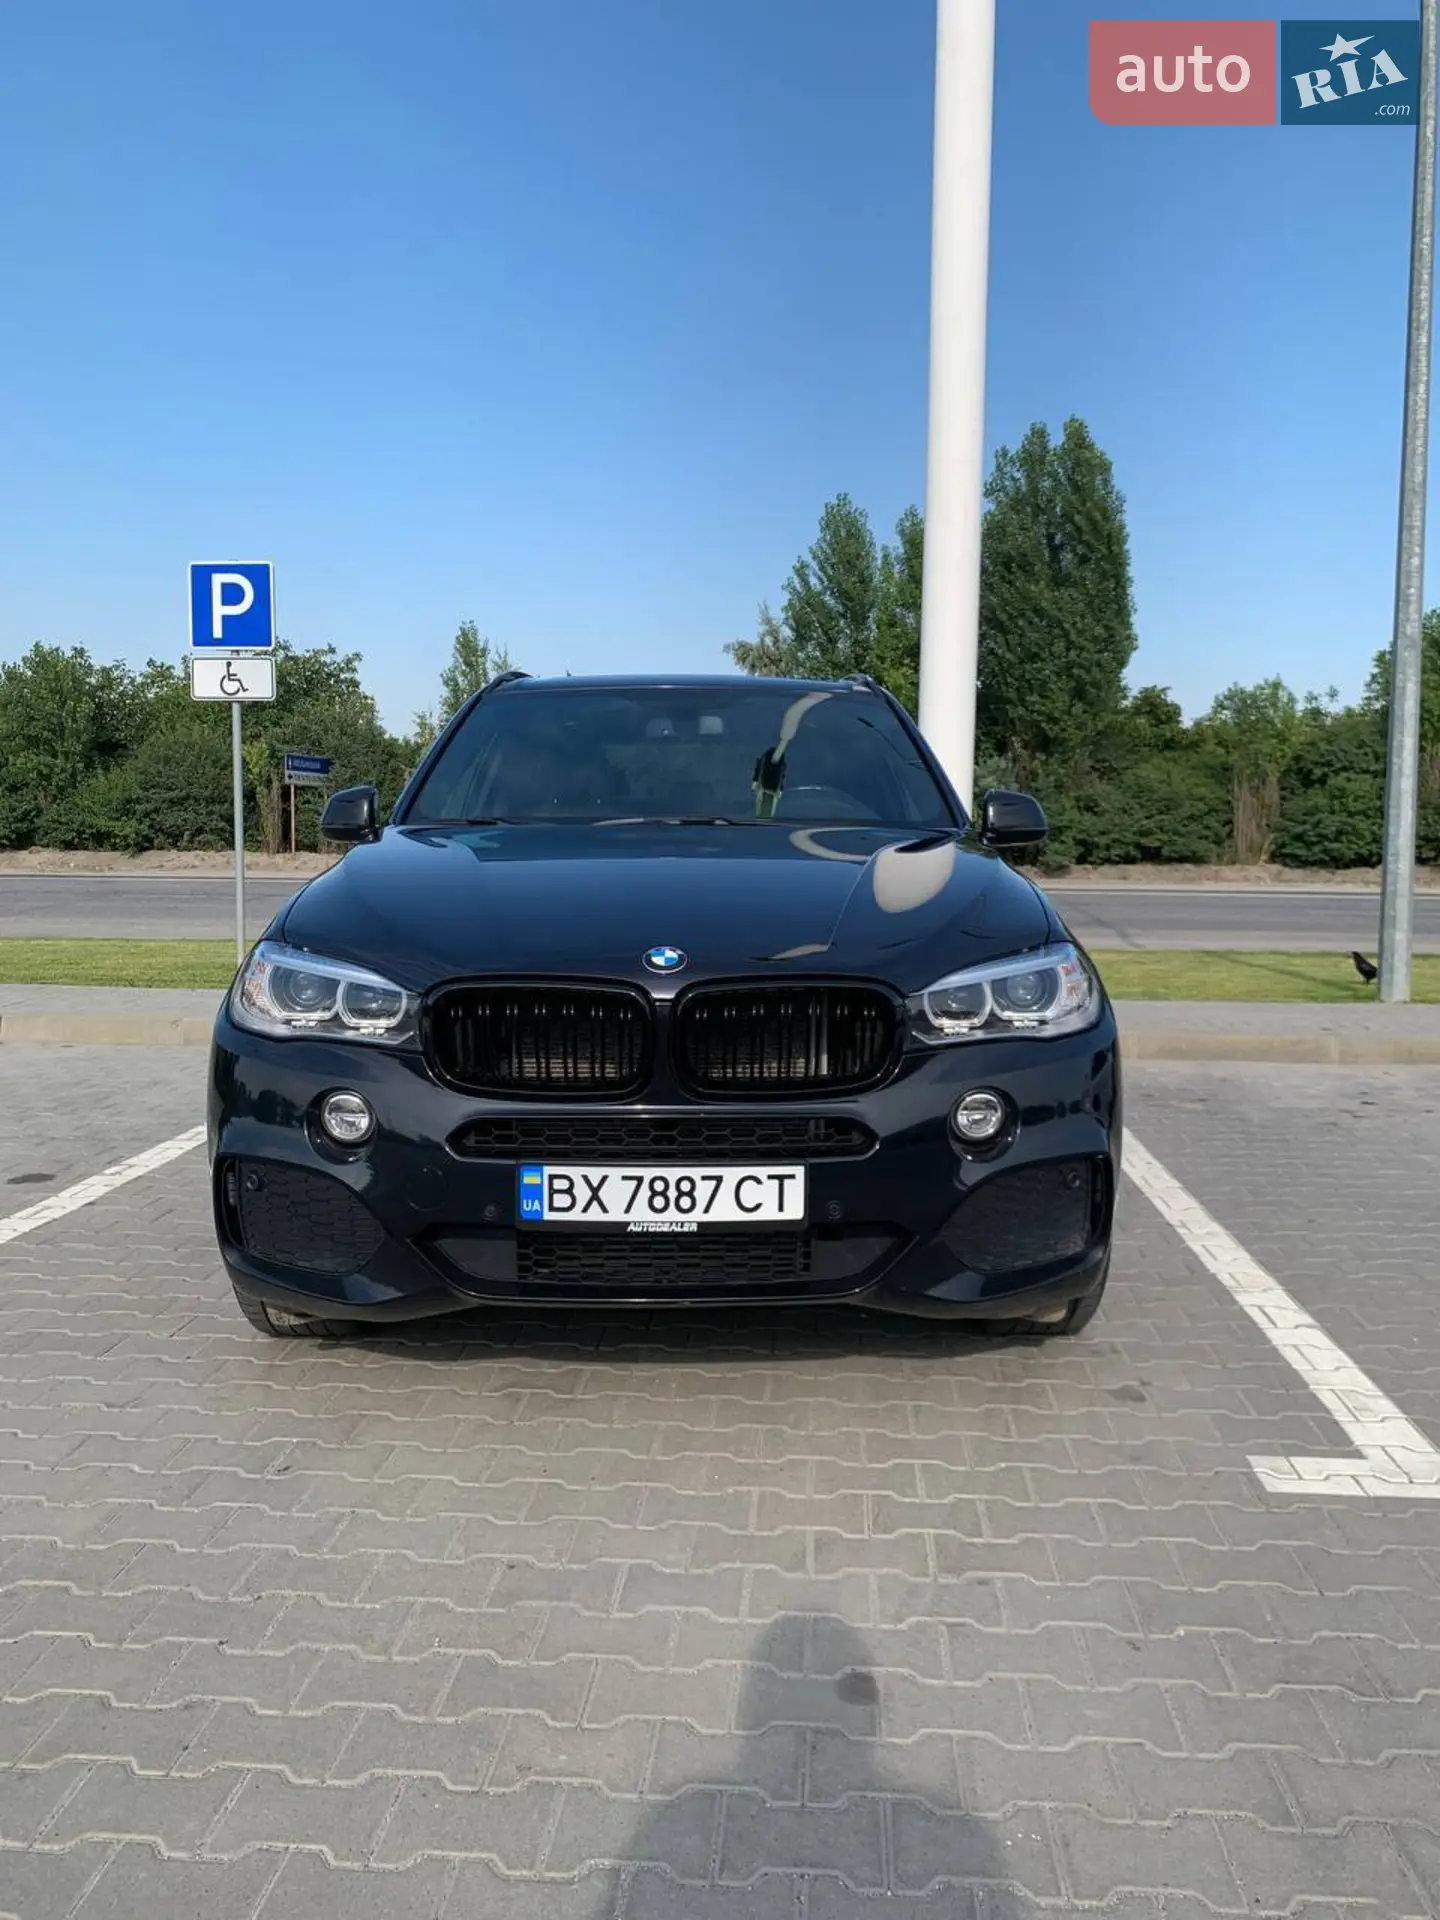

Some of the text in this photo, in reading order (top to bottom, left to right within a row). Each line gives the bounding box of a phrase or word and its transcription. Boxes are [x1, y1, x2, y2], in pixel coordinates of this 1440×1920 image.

[211, 573, 255, 639] P
[523, 1199, 541, 1212] UA
[547, 1173, 796, 1214] BX 7887 CT
[626, 1222, 698, 1233] AUTODEALER
